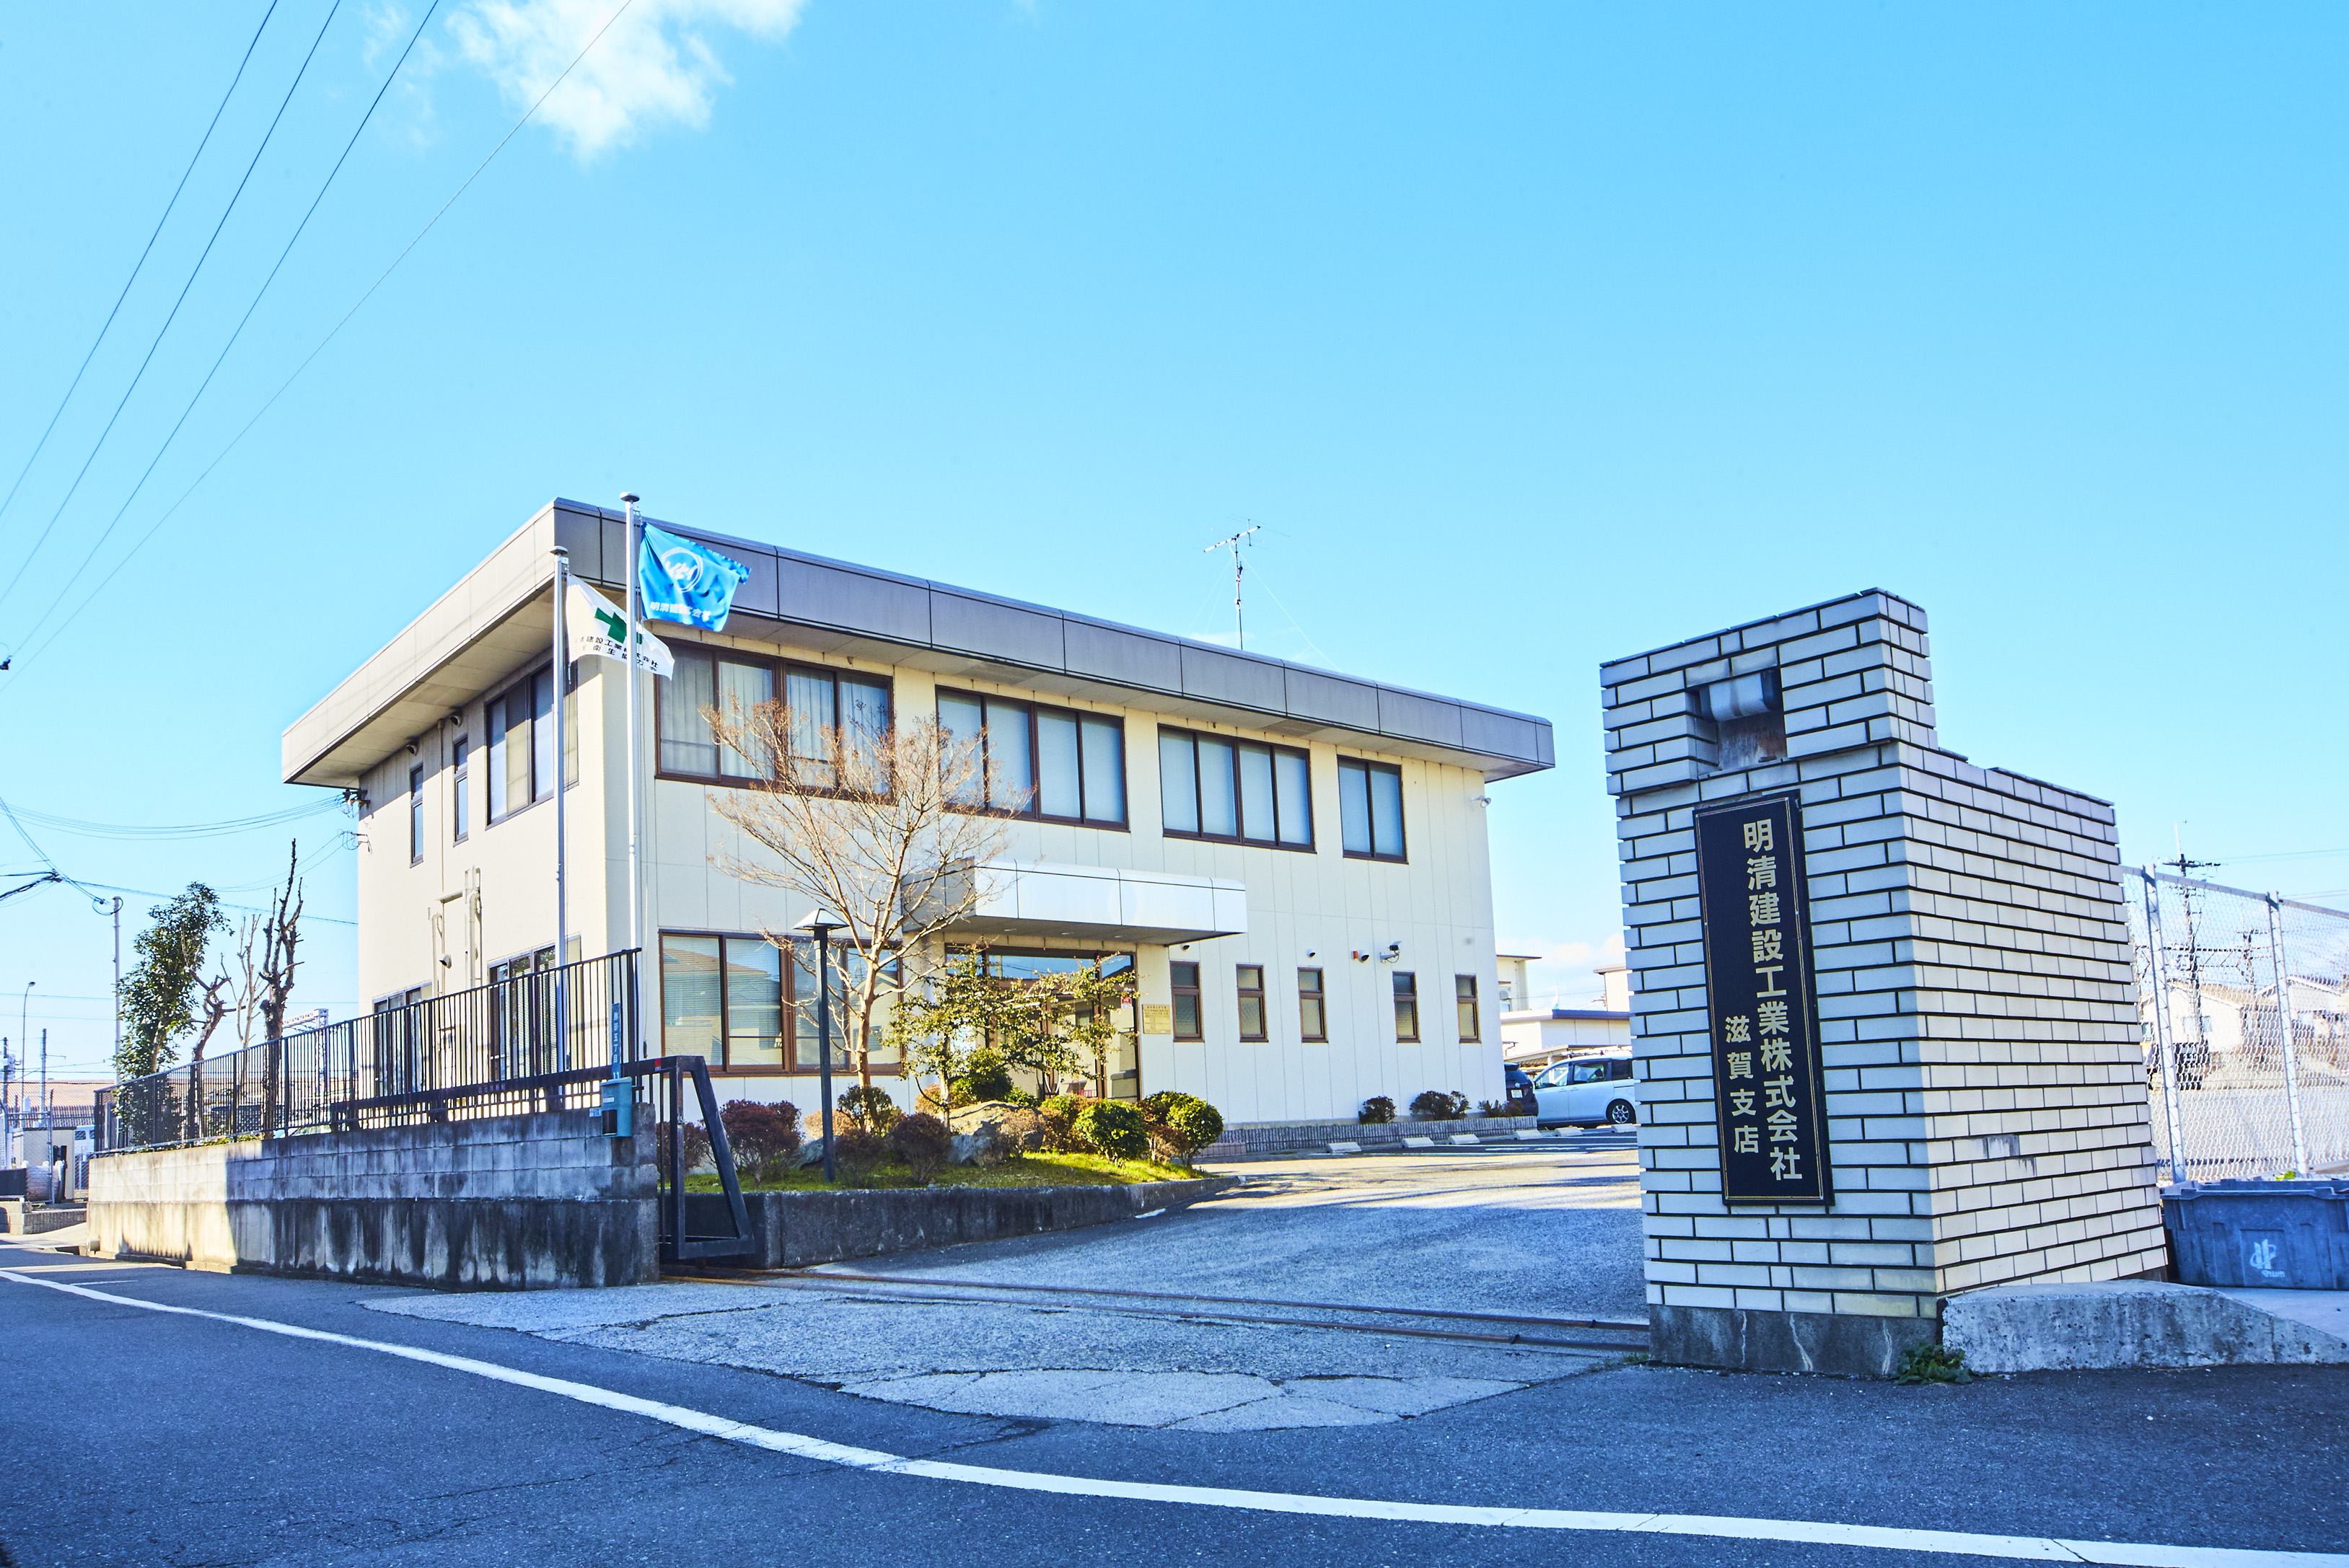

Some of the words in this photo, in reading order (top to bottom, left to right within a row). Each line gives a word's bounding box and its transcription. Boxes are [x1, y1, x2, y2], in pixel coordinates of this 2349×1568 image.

[1725, 1016, 1759, 1154] 滋賀支店
[1743, 818, 1803, 1181] 明清建設工業株式会社
